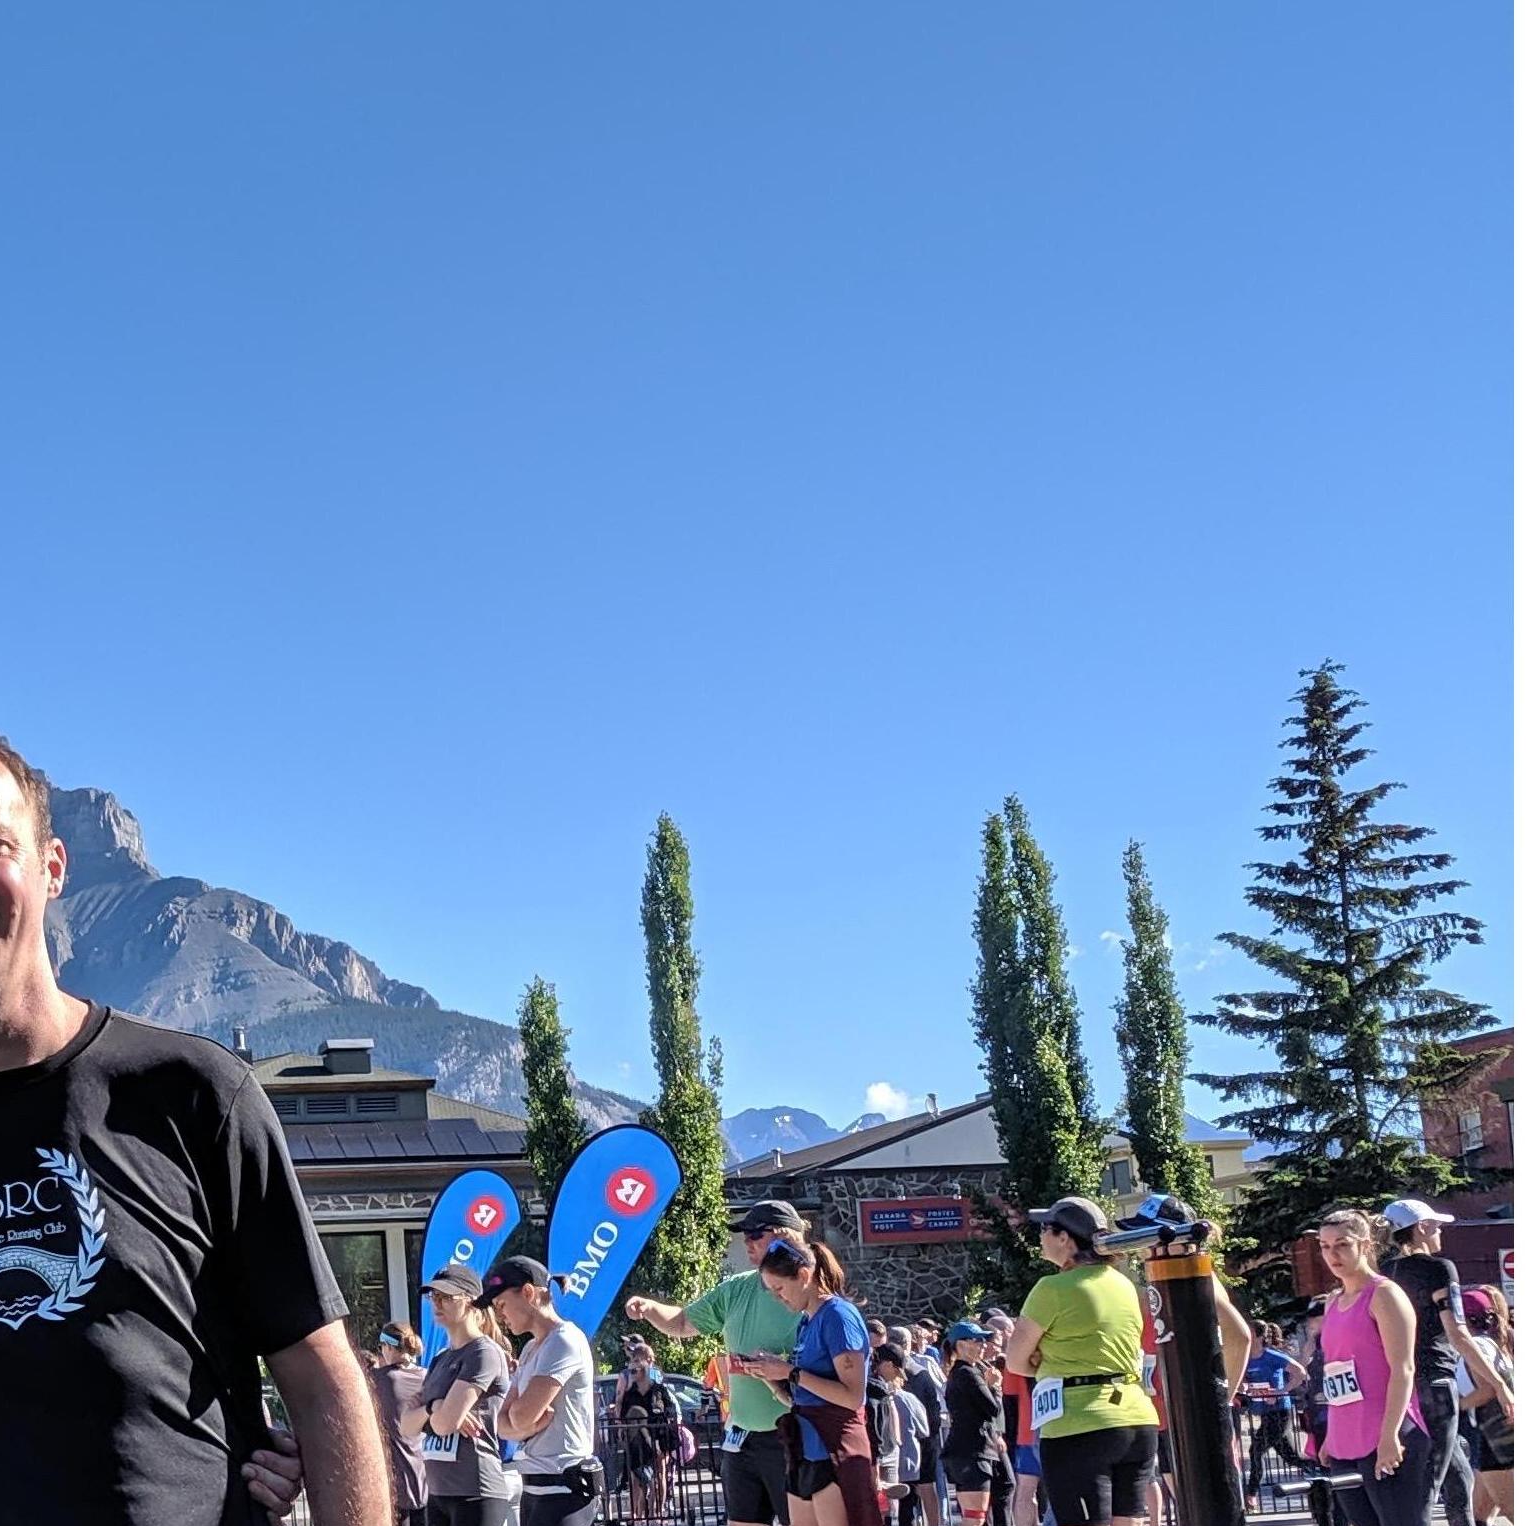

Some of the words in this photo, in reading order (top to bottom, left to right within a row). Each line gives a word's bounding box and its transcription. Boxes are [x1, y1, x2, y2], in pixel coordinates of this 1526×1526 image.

[874, 1212, 907, 1220] CANADA
[7, 1228, 42, 1241] Running
[43, 1221, 67, 1235] Club
[928, 1220, 959, 1228] CANADA
[567, 1220, 619, 1300] BMO
